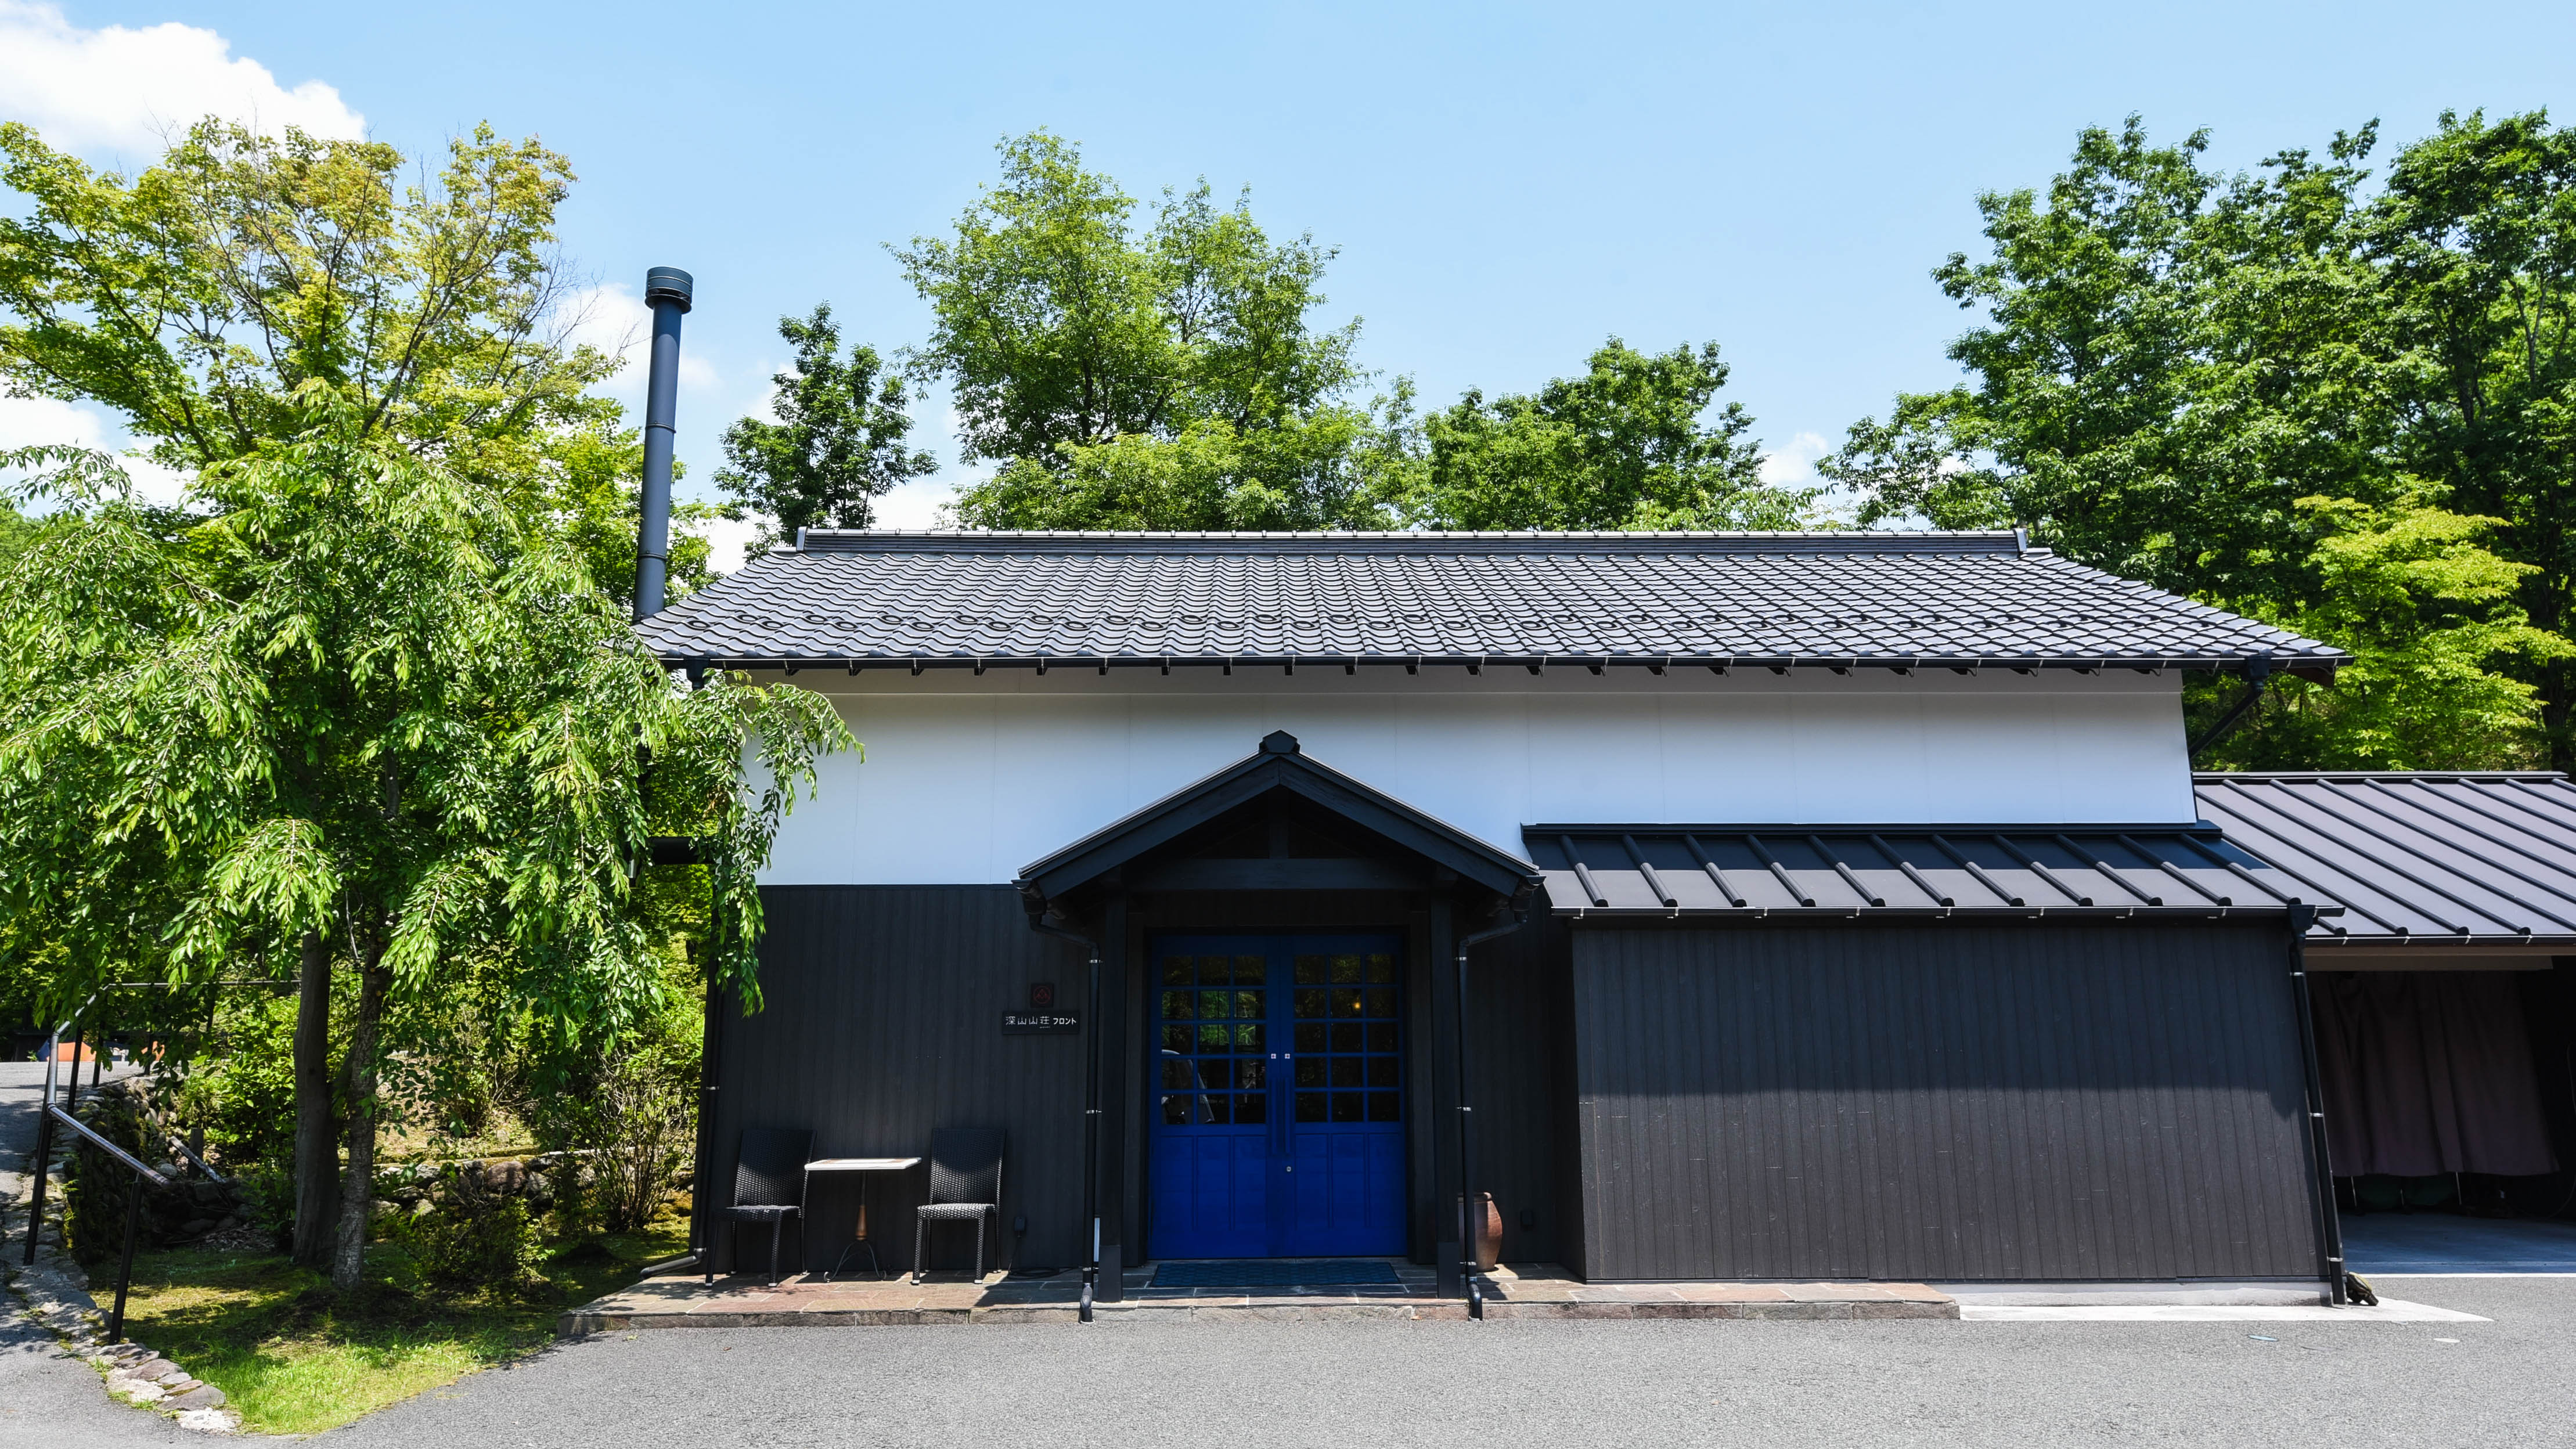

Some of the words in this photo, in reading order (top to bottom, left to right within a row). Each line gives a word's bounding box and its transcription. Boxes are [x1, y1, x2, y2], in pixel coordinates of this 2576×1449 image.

[1006, 1016, 1050, 1025] 深山山荘
[1053, 1017, 1077, 1025] フロント
